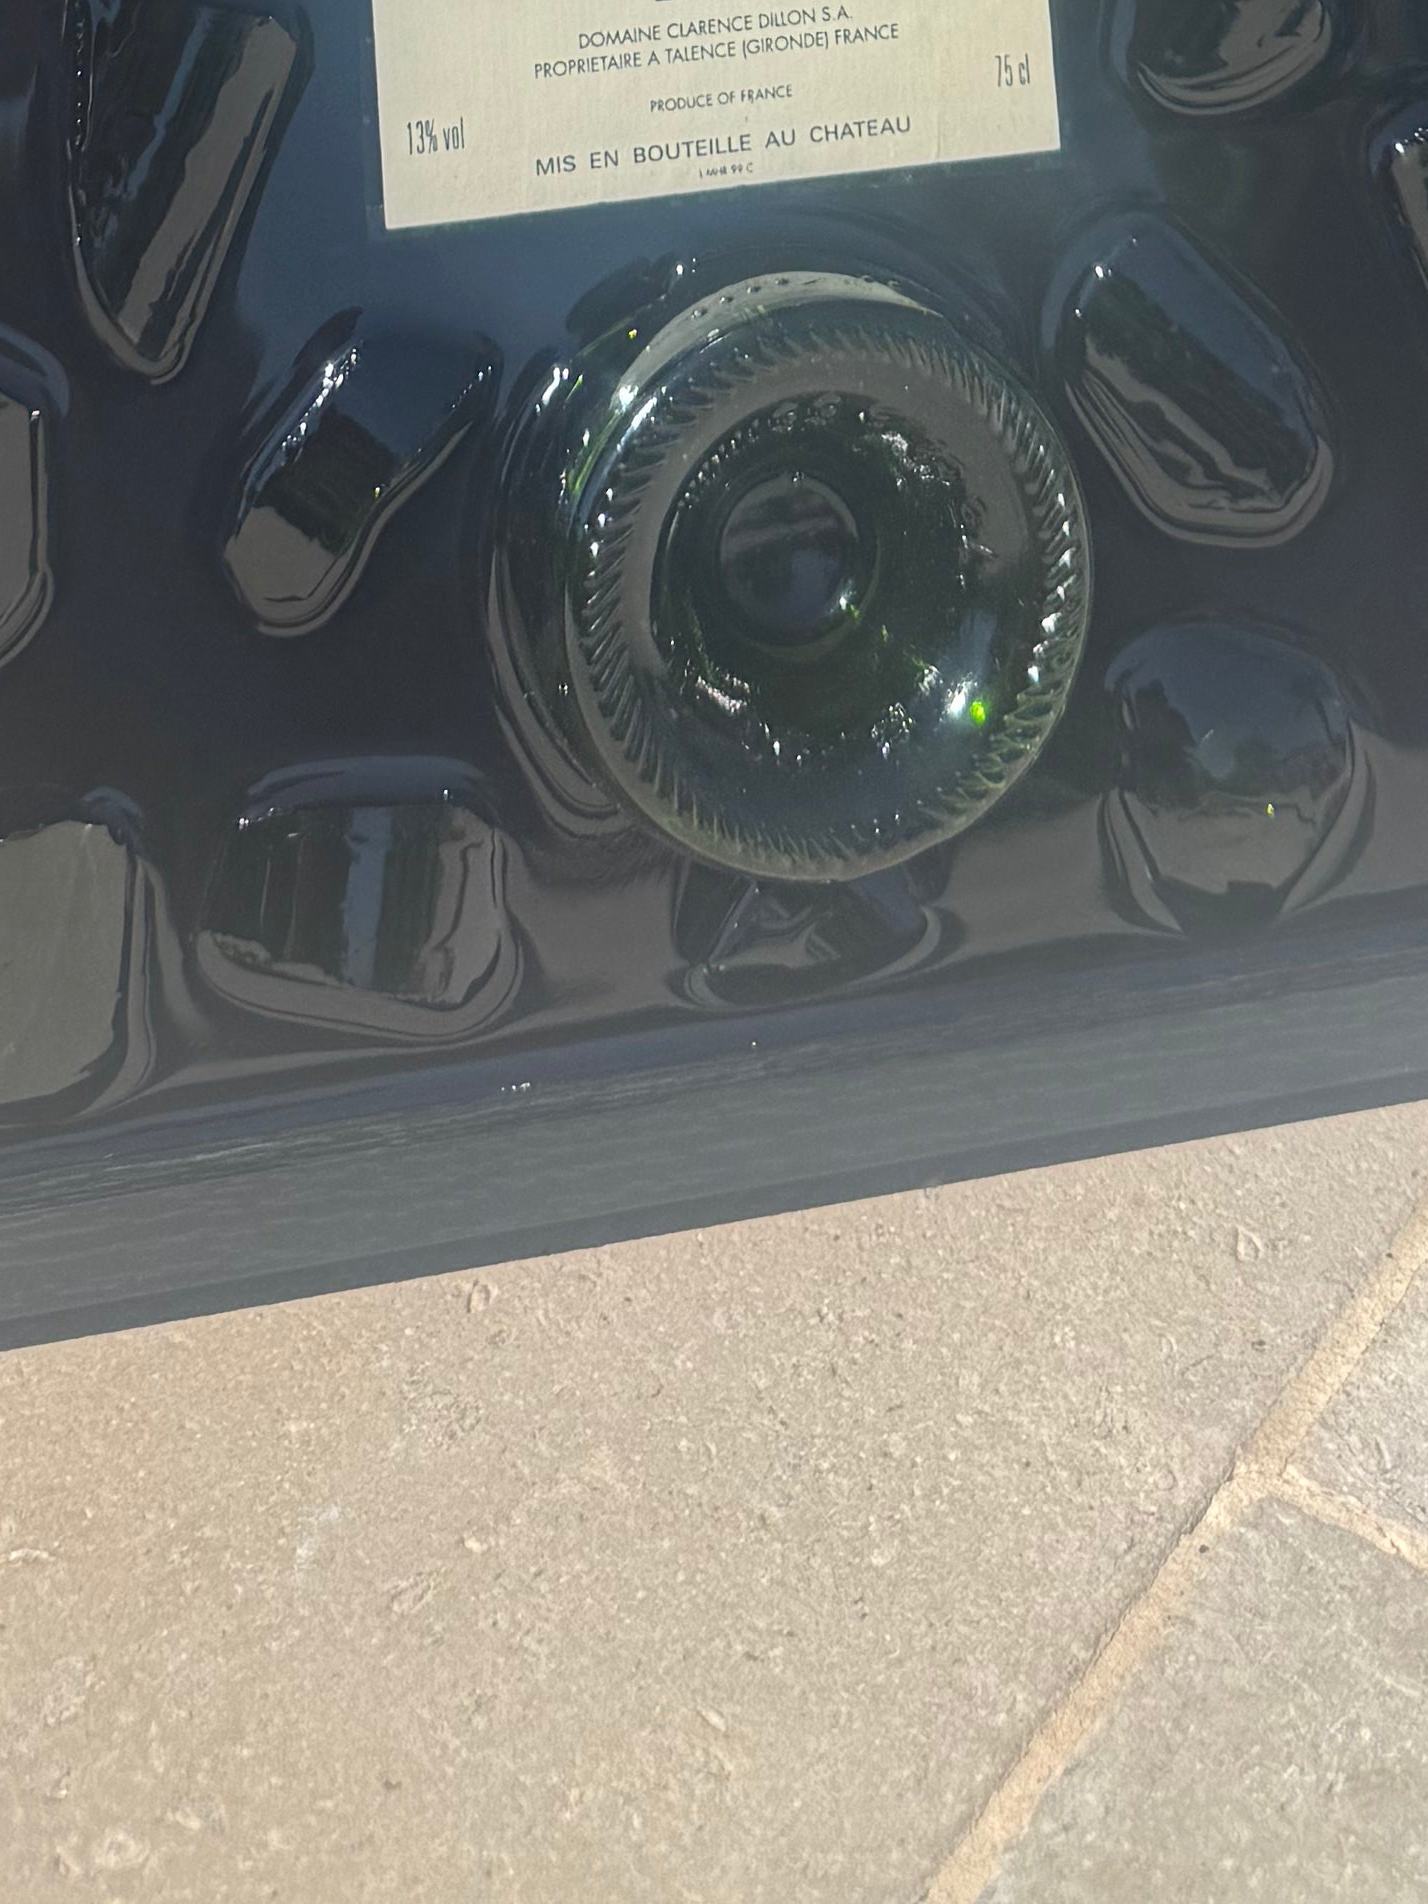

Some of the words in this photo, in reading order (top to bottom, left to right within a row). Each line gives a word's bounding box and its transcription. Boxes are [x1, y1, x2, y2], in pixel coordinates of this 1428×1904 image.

[579, 24, 661, 49] DOMAINE
[667, 15, 752, 40] CLARENCE
[759, 7, 816, 29] DILLON
[822, 4, 854, 21] S.A.
[534, 52, 642, 79] PROPRIETAIRE
[647, 51, 661, 65] A
[665, 42, 736, 64] TALENCE
[742, 30, 829, 60] (GIRONDE)
[835, 23, 900, 45] FRANCE
[994, 54, 1013, 87] 75
[1018, 52, 1030, 85] cl
[650, 96, 713, 113] PRODUCE
[717, 91, 735, 105] OF
[741, 84, 793, 103] FRANCE
[407, 118, 438, 155] 13%
[442, 115, 465, 151] vol
[536, 155, 576, 176] MIS
[590, 150, 619, 170] EN
[633, 134, 752, 164] BOUTEILLE
[765, 129, 796, 149] AU
[809, 116, 911, 142] CHATEAU
